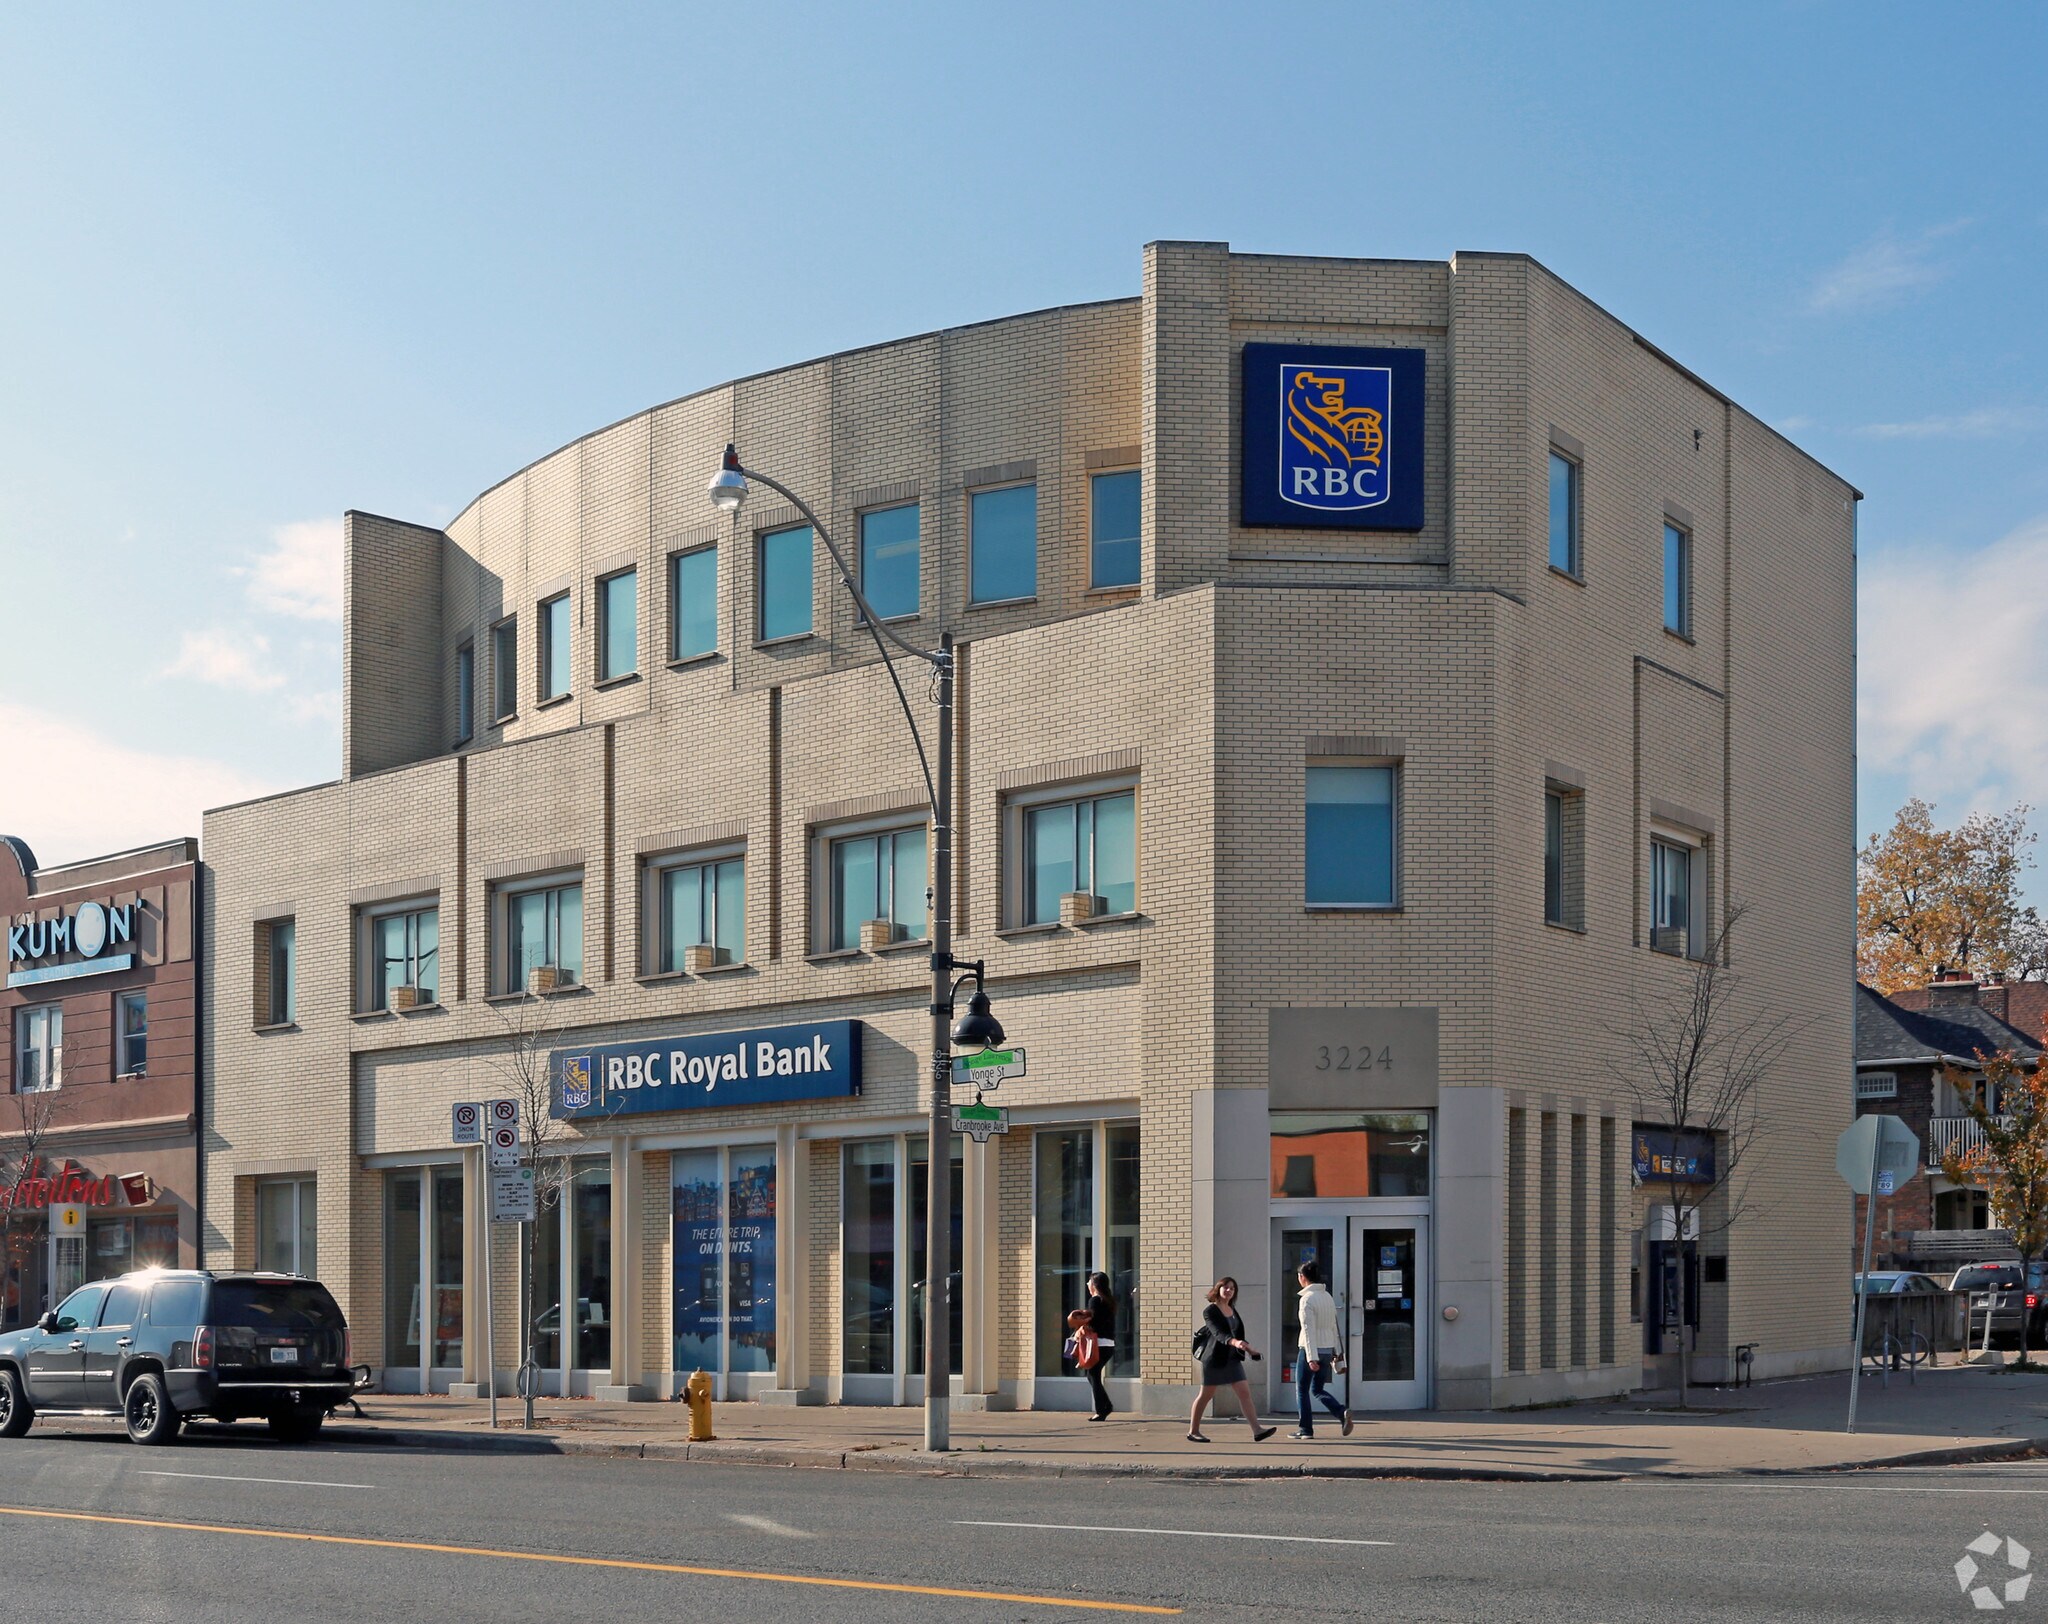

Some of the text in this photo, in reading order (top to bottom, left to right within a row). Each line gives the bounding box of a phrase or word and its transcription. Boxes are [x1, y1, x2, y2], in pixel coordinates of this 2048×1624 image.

[1292, 467, 1378, 497] RBC
[8, 901, 131, 962] KUMON
[608, 1034, 832, 1092] RBC Royal Bank
[1315, 1045, 1393, 1071] 3224
[971, 1066, 1005, 1081] Yonge St
[566, 1093, 588, 1105] RBC
[955, 1120, 1004, 1132] Cranbrooke Ave
[13, 1153, 112, 1209] Hortons
[692, 1229, 708, 1240] THE
[741, 1226, 761, 1239] TRIP,
[699, 1242, 714, 1255] ON
